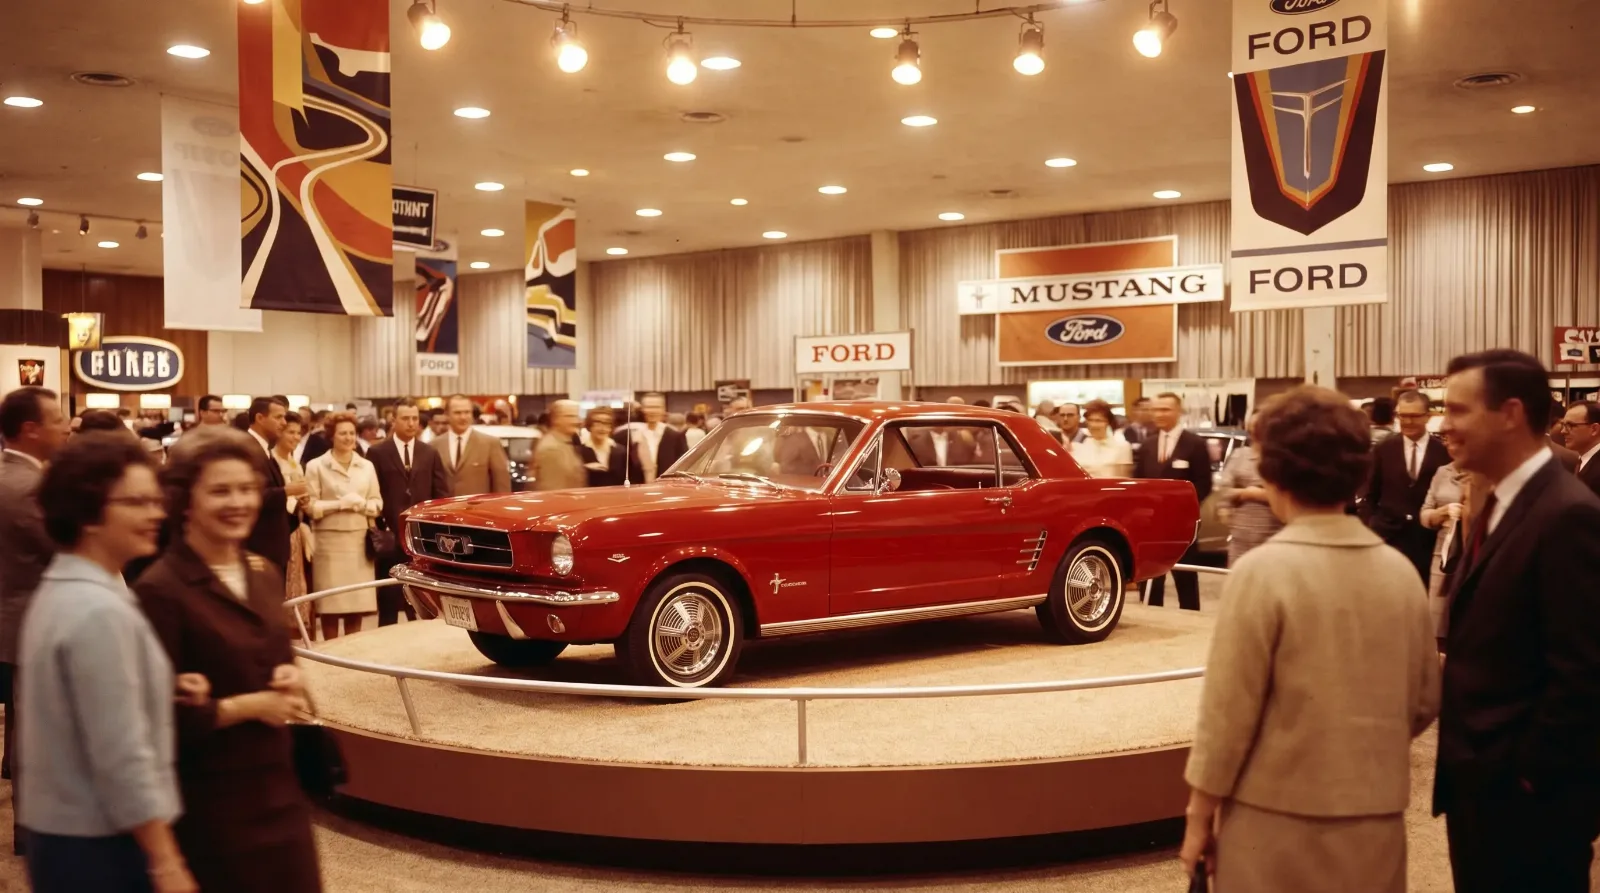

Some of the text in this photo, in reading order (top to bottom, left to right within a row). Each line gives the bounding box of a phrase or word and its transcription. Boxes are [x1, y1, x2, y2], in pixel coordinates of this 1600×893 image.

[1248, 15, 1372, 60] FORD
[1011, 274, 1207, 304] MUSTANG
[1249, 262, 1368, 294] FORD
[1060, 319, 1108, 342] Ford
[420, 359, 455, 370] FORD
[811, 343, 895, 363] FORD
